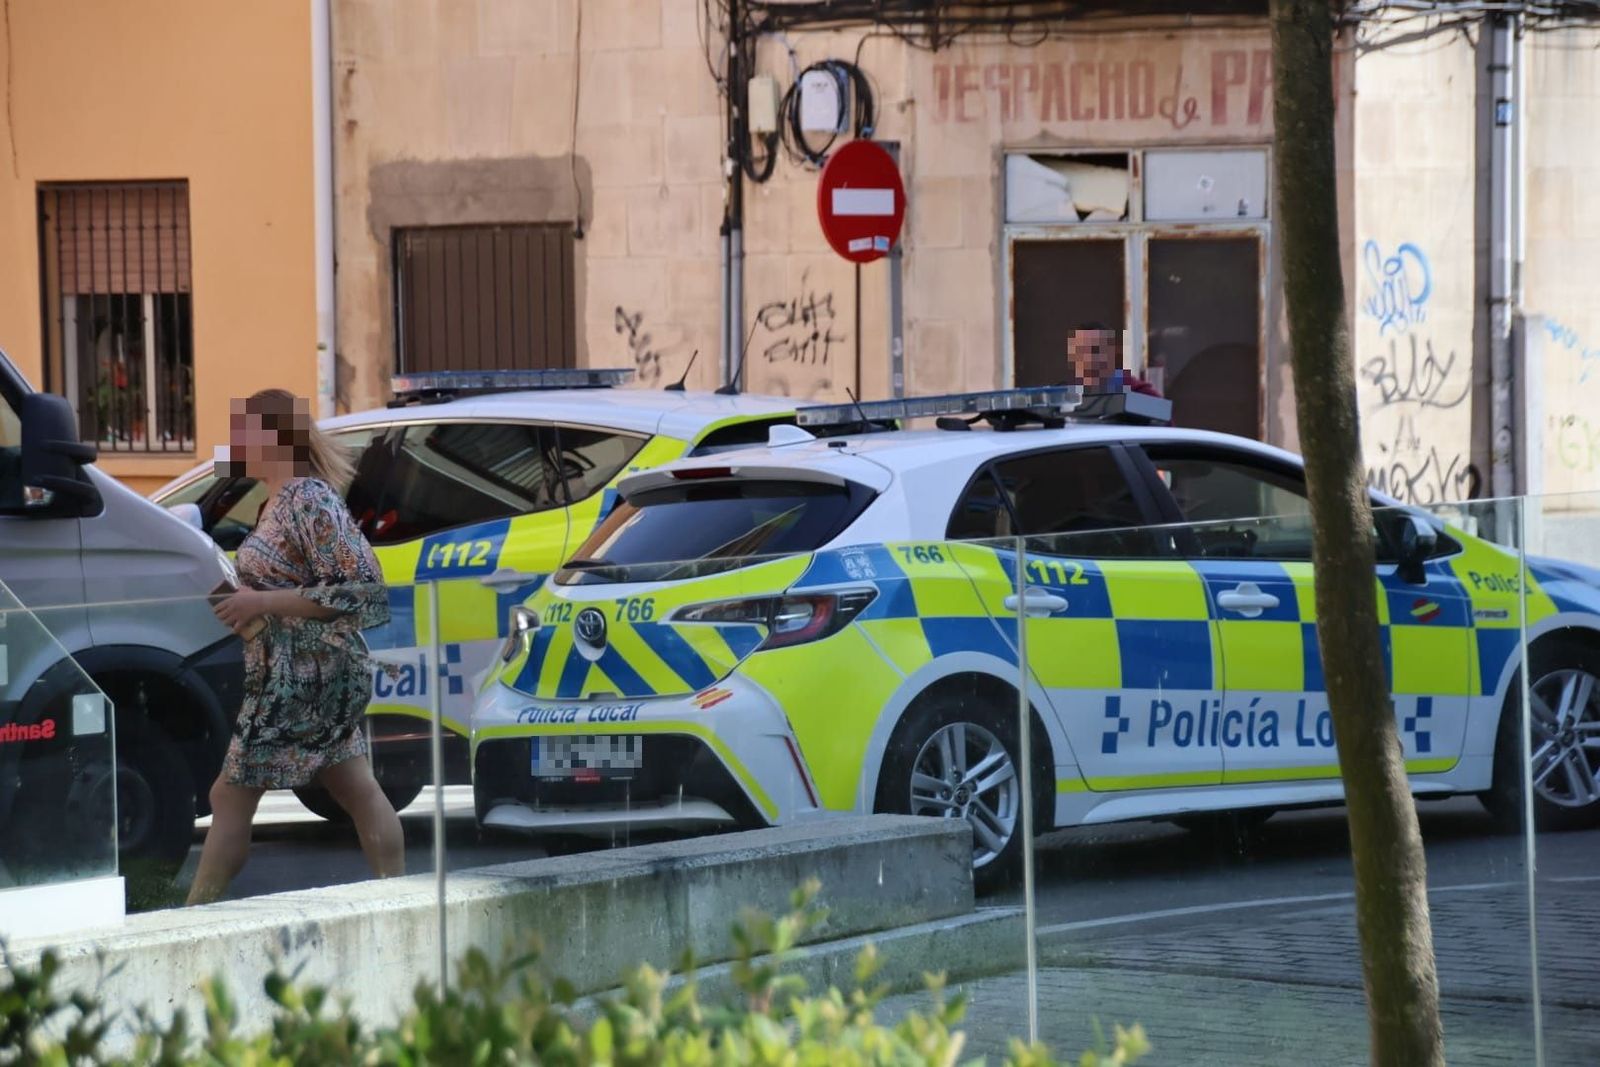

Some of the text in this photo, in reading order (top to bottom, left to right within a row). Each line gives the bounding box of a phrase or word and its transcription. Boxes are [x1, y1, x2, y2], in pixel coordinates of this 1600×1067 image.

[1159, 65, 1200, 129] de
[897, 545, 944, 564] 766
[615, 597, 655, 622] 766
[374, 653, 427, 698] cal
[1147, 697, 1280, 748] Policía
